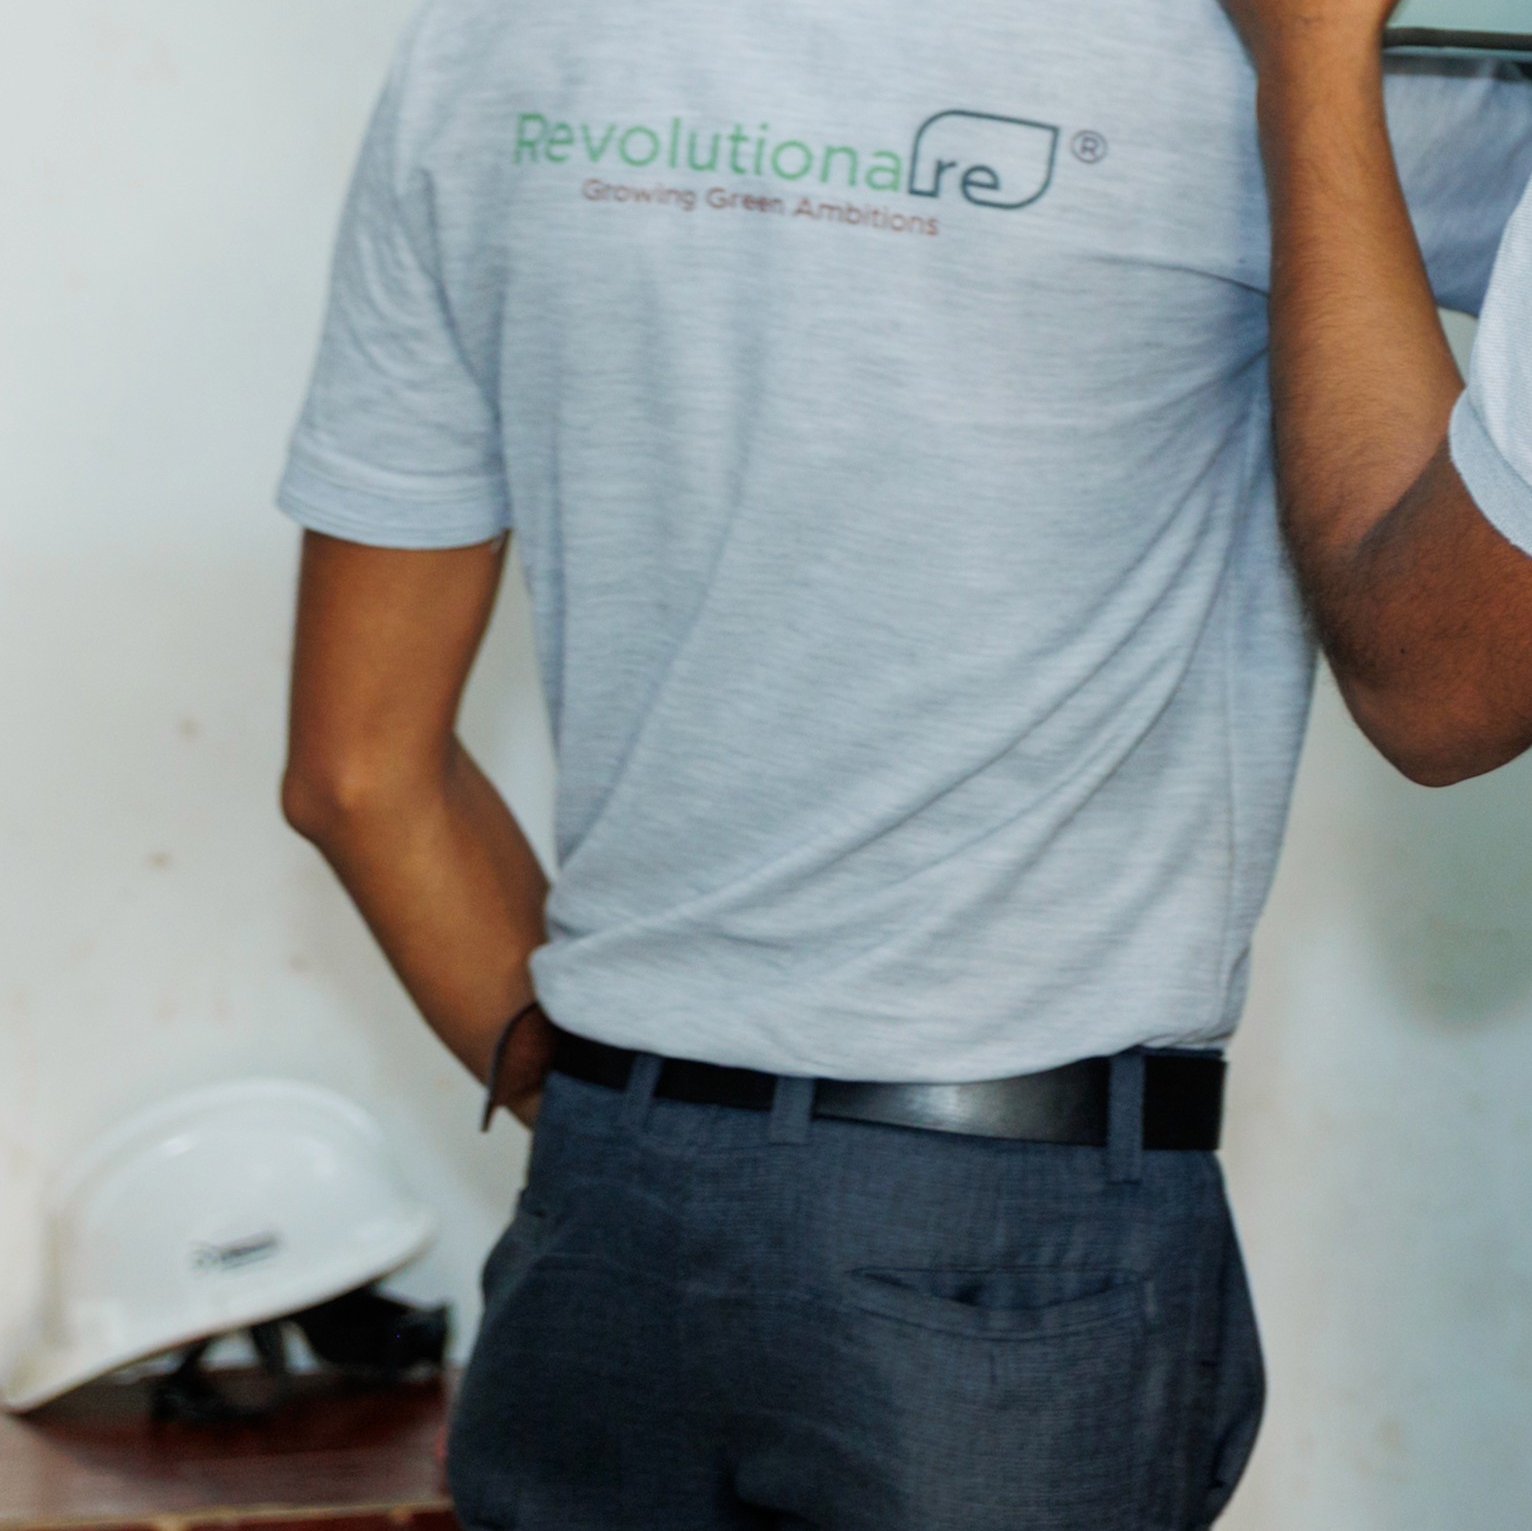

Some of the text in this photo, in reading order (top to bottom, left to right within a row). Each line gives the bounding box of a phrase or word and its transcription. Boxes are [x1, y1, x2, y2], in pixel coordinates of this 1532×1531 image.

[581, 177, 940, 237] Growing Green Ambitions
